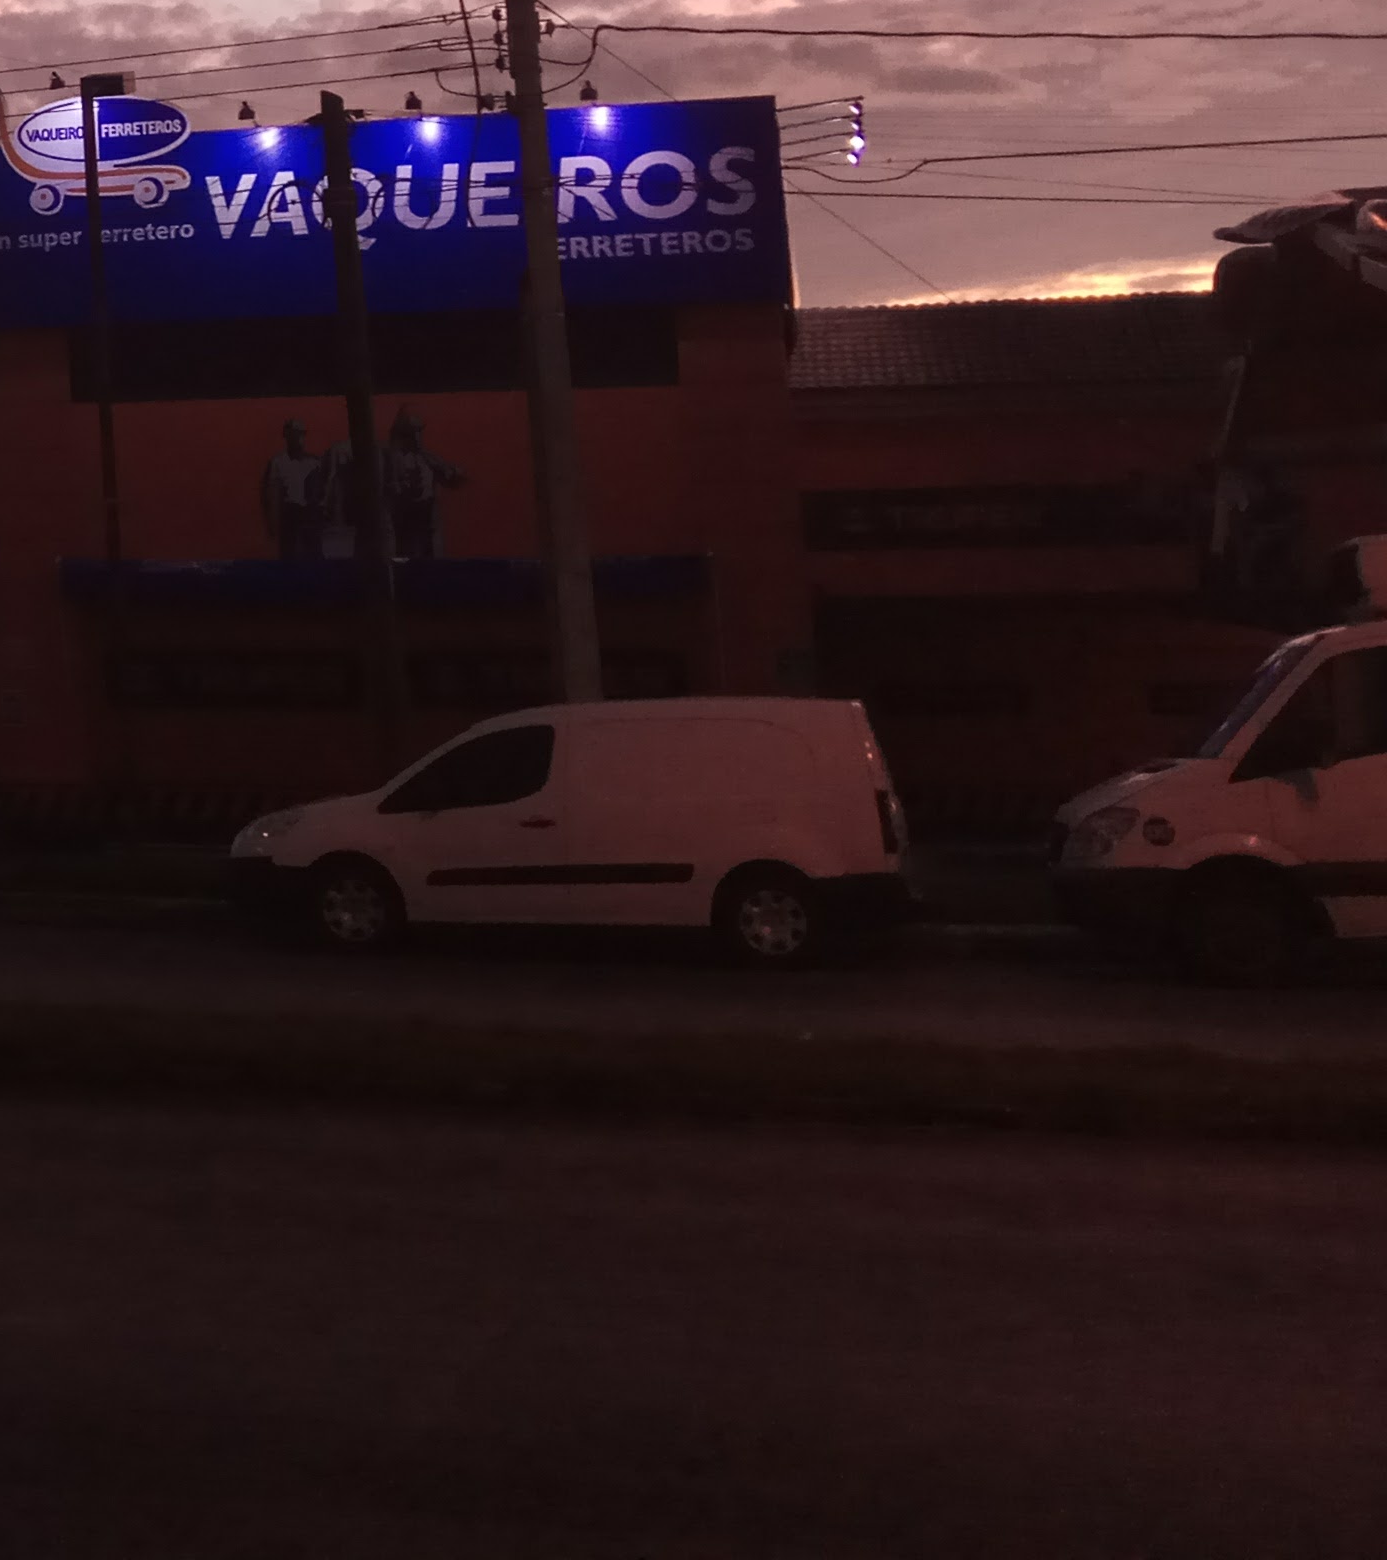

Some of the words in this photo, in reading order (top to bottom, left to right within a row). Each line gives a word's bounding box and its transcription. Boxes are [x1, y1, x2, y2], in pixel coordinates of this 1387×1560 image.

[26, 127, 84, 142] VAQUEIRO
[101, 120, 182, 138] FERRETEROS
[205, 146, 756, 250] VAQUEROS
[18, 230, 83, 252] super
[100, 223, 195, 243] erretero
[556, 228, 756, 260] ERRETEROS
